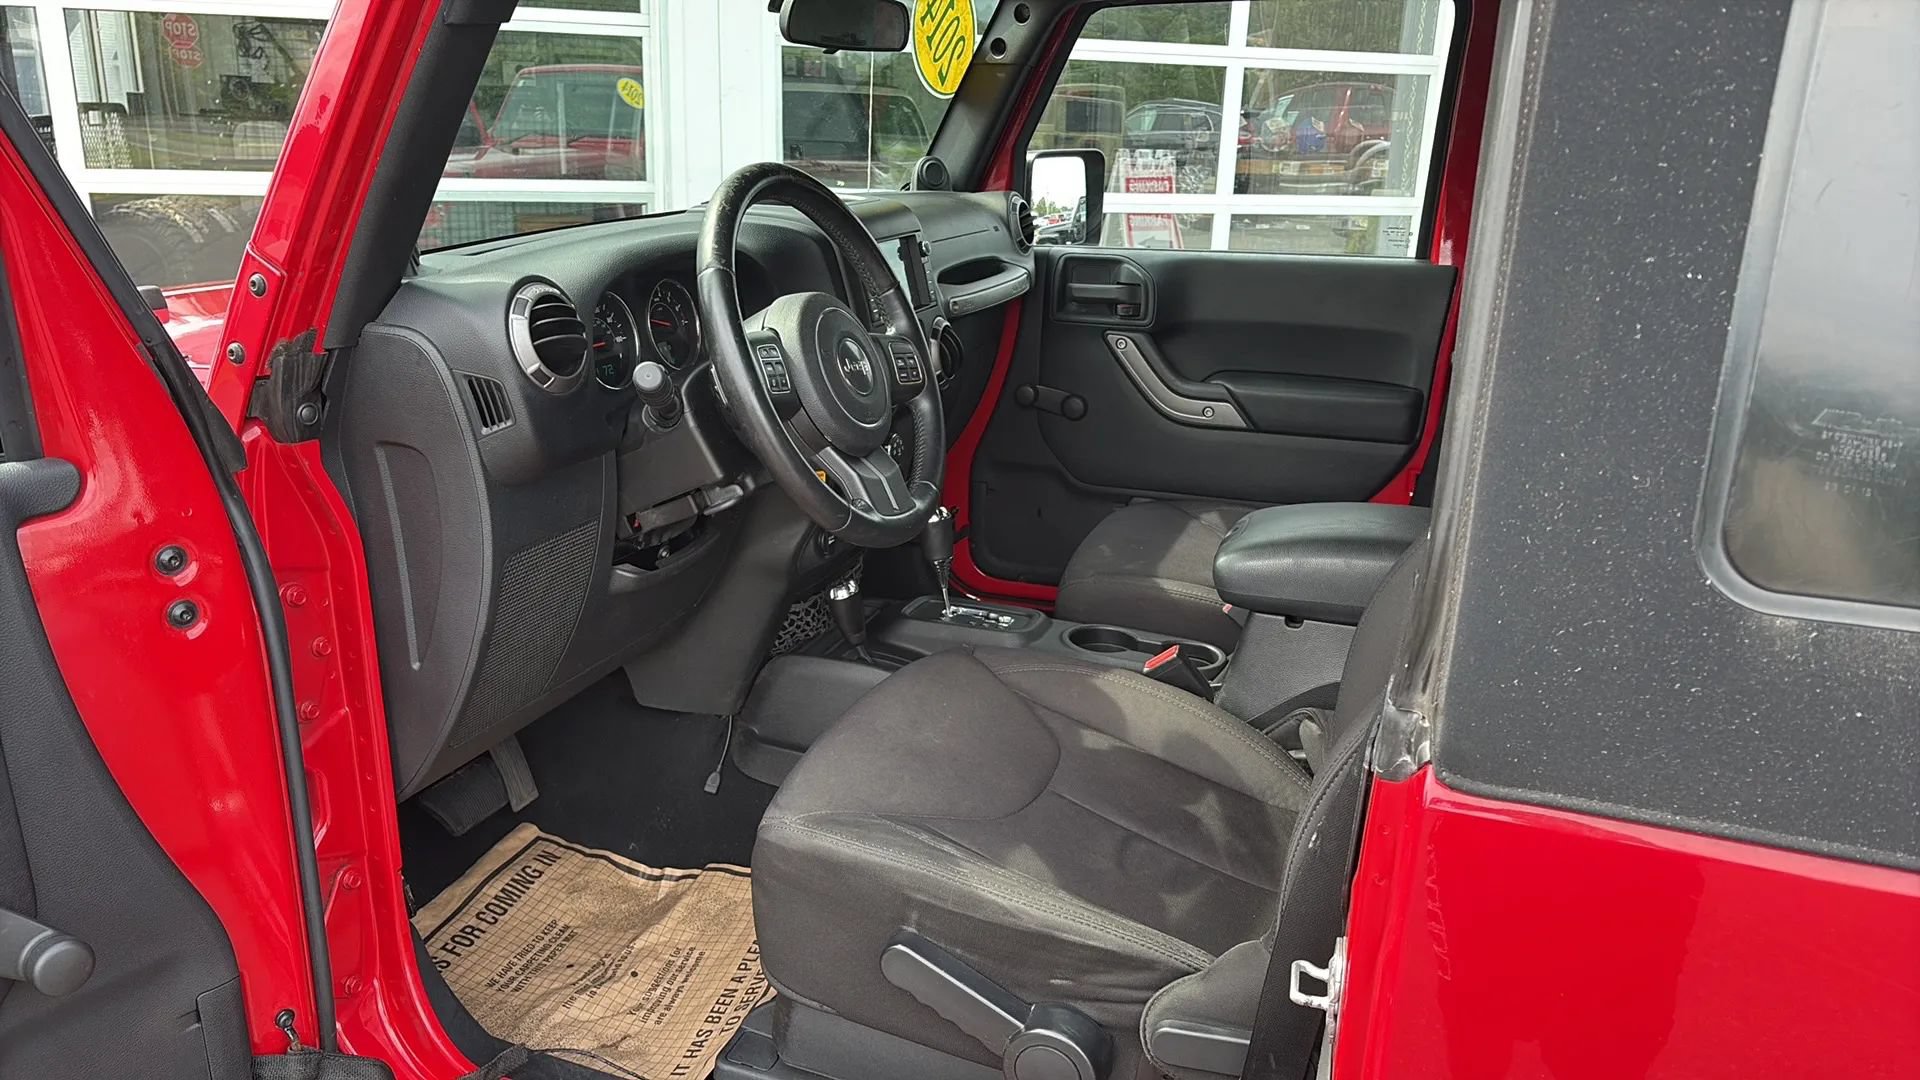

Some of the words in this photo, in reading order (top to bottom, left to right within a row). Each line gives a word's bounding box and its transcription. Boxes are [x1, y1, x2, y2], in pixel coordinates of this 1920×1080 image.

[602, 364, 615, 377] 72
[843, 358, 870, 376] Jeep
[440, 924, 486, 957] FOR
[475, 865, 544, 926] COMING
[533, 850, 562, 866] IN
[485, 976, 500, 988] WE
[496, 960, 518, 979] HAVE
[513, 943, 535, 962] TRIED
[532, 934, 545, 944] TO
[541, 919, 558, 936] KEEP
[496, 975, 517, 993] YOUR
[549, 924, 570, 944] CLEAN
[642, 959, 675, 1002] suggestions
[669, 947, 682, 958] for
[511, 974, 532, 993] WITH
[562, 996, 577, 1010] the
[640, 986, 672, 1024] improving
[666, 973, 679, 986] our
[675, 946, 696, 974] service
[654, 1012, 668, 1025] are
[664, 985, 685, 1012] always
[670, 1064, 690, 1077] IT
[683, 1028, 713, 1059] HAS
[704, 988, 739, 1024] BEEN
[731, 975, 747, 984] A
[719, 1016, 740, 1035] TO
